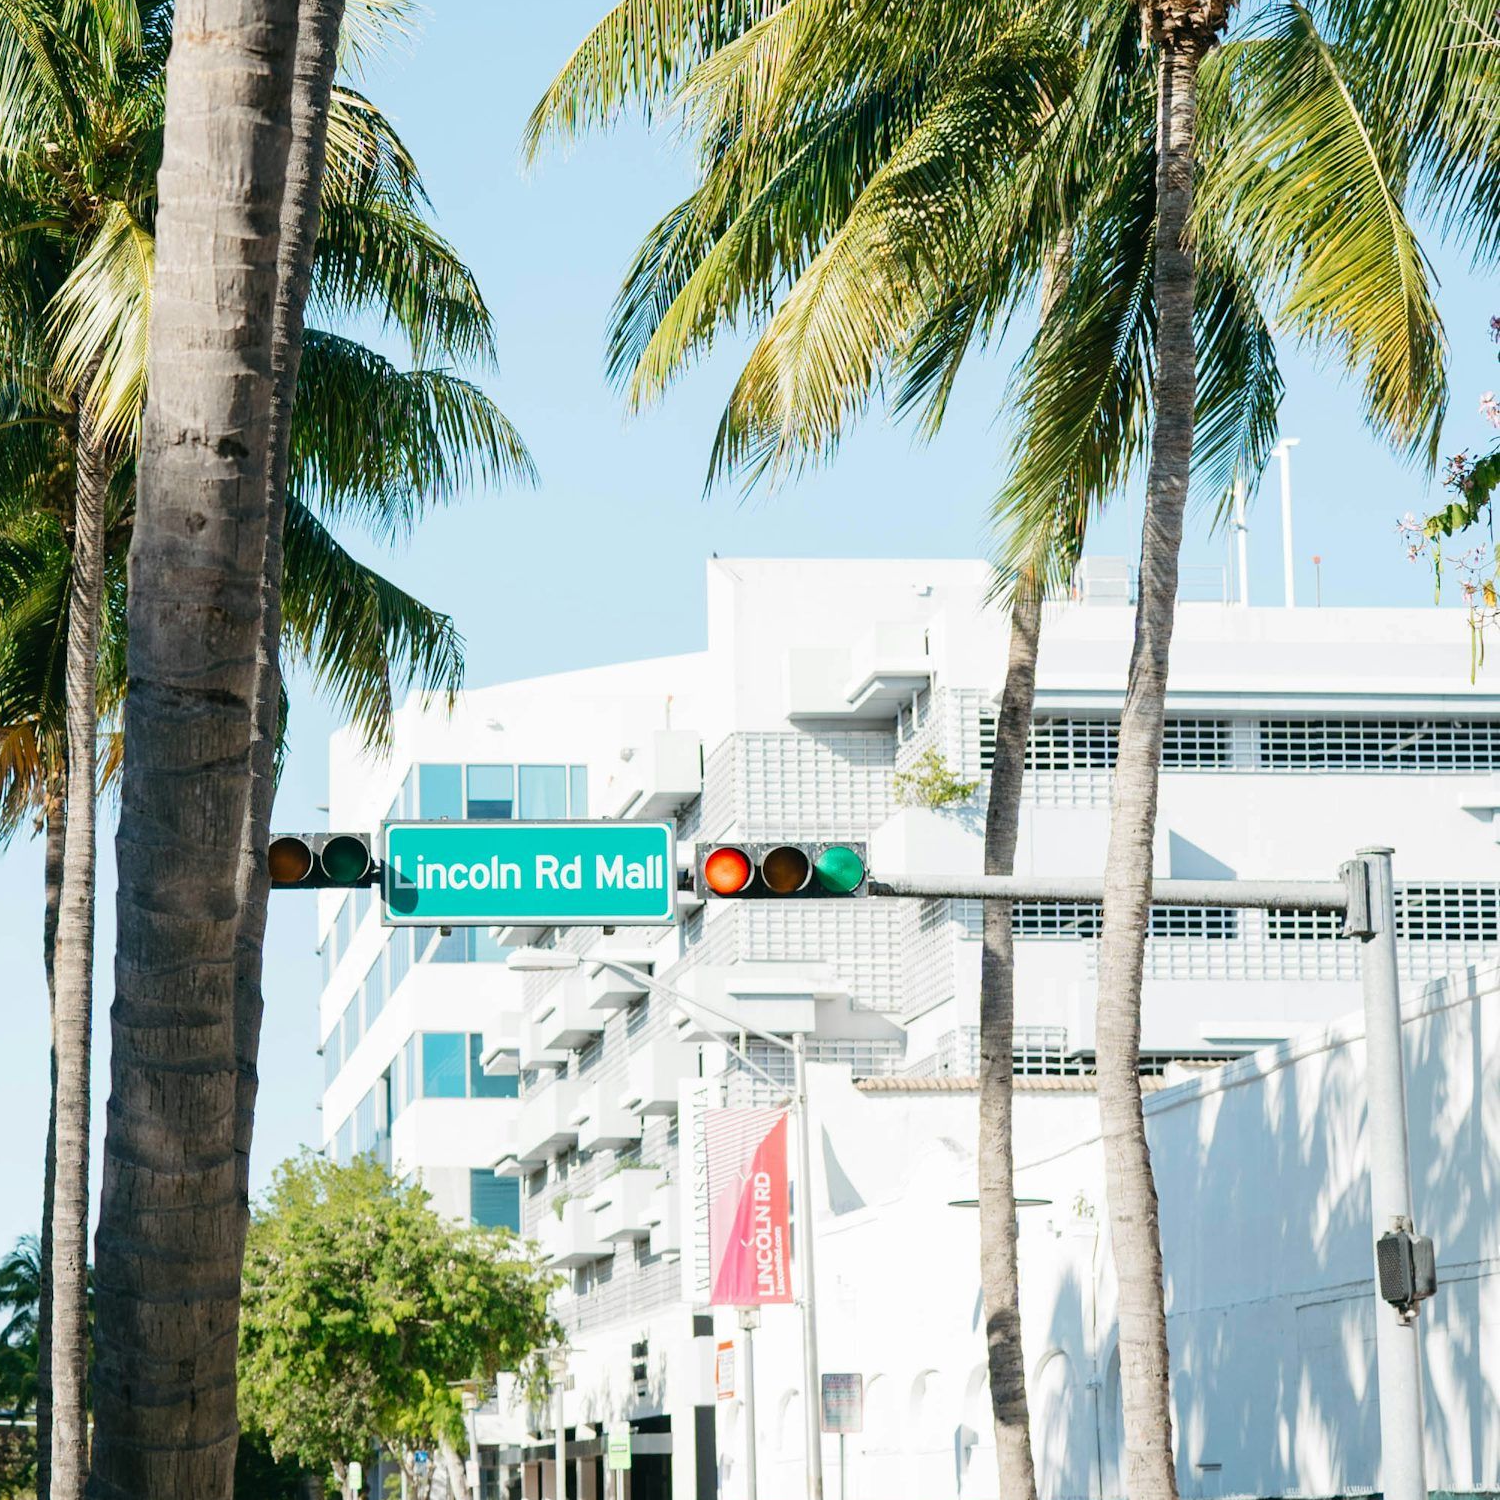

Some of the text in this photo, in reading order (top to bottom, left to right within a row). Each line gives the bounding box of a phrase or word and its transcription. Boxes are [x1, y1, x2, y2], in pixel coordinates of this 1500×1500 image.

[393, 854, 664, 890] Lincoln Rd Mall
[754, 1171, 774, 1296] LINCOLN RD
